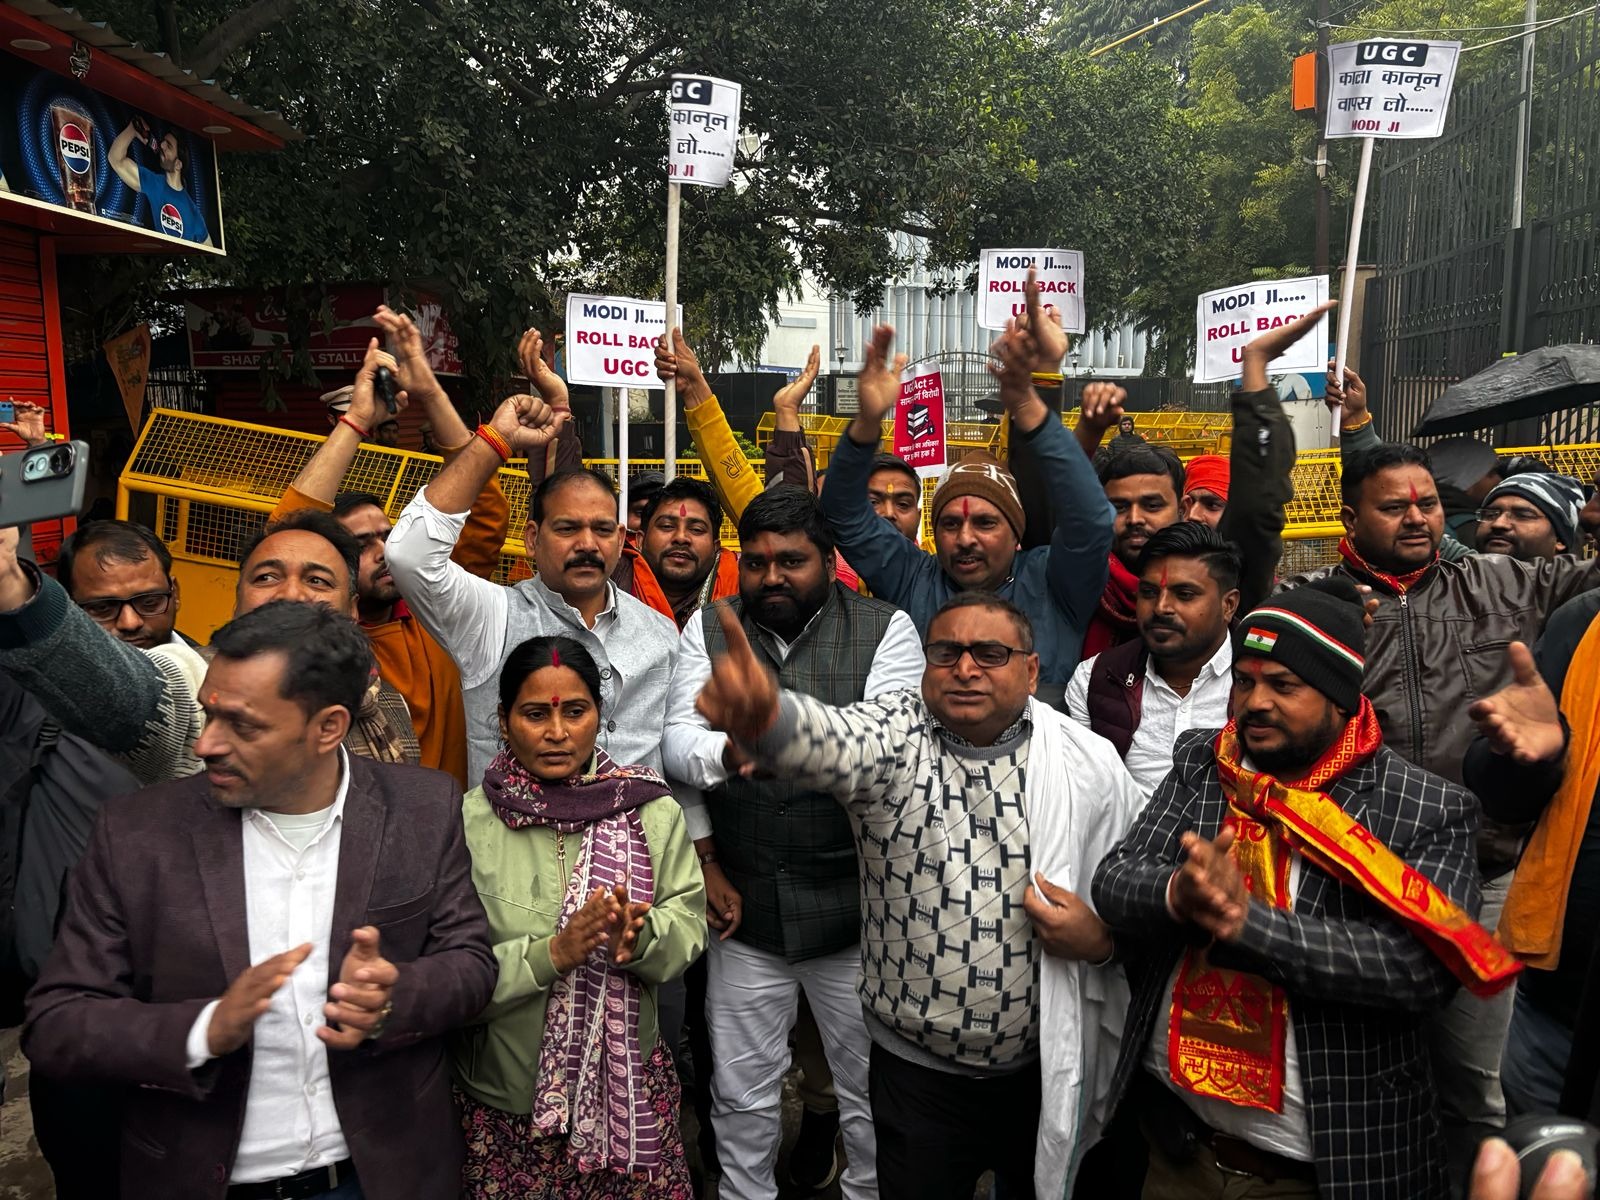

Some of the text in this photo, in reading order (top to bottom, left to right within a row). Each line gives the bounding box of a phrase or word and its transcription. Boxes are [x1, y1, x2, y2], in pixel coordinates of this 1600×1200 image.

[1363, 45, 1417, 62] UGC
[1339, 70, 1443, 92] काला कानून
[1337, 96, 1373, 112] वापस
[673, 109, 728, 133] कानून
[1388, 121, 1400, 133] JI
[61, 139, 90, 158] PEPSI
[683, 164, 695, 177] JI
[161, 213, 183, 232] PEPSI
[583, 303, 627, 321] MODI
[1212, 291, 1255, 314] MODI
[576, 330, 661, 349] ROLL BAC
[1207, 320, 1251, 341] ROLL
[319, 353, 361, 363] STALL
[603, 358, 649, 377] UGC
